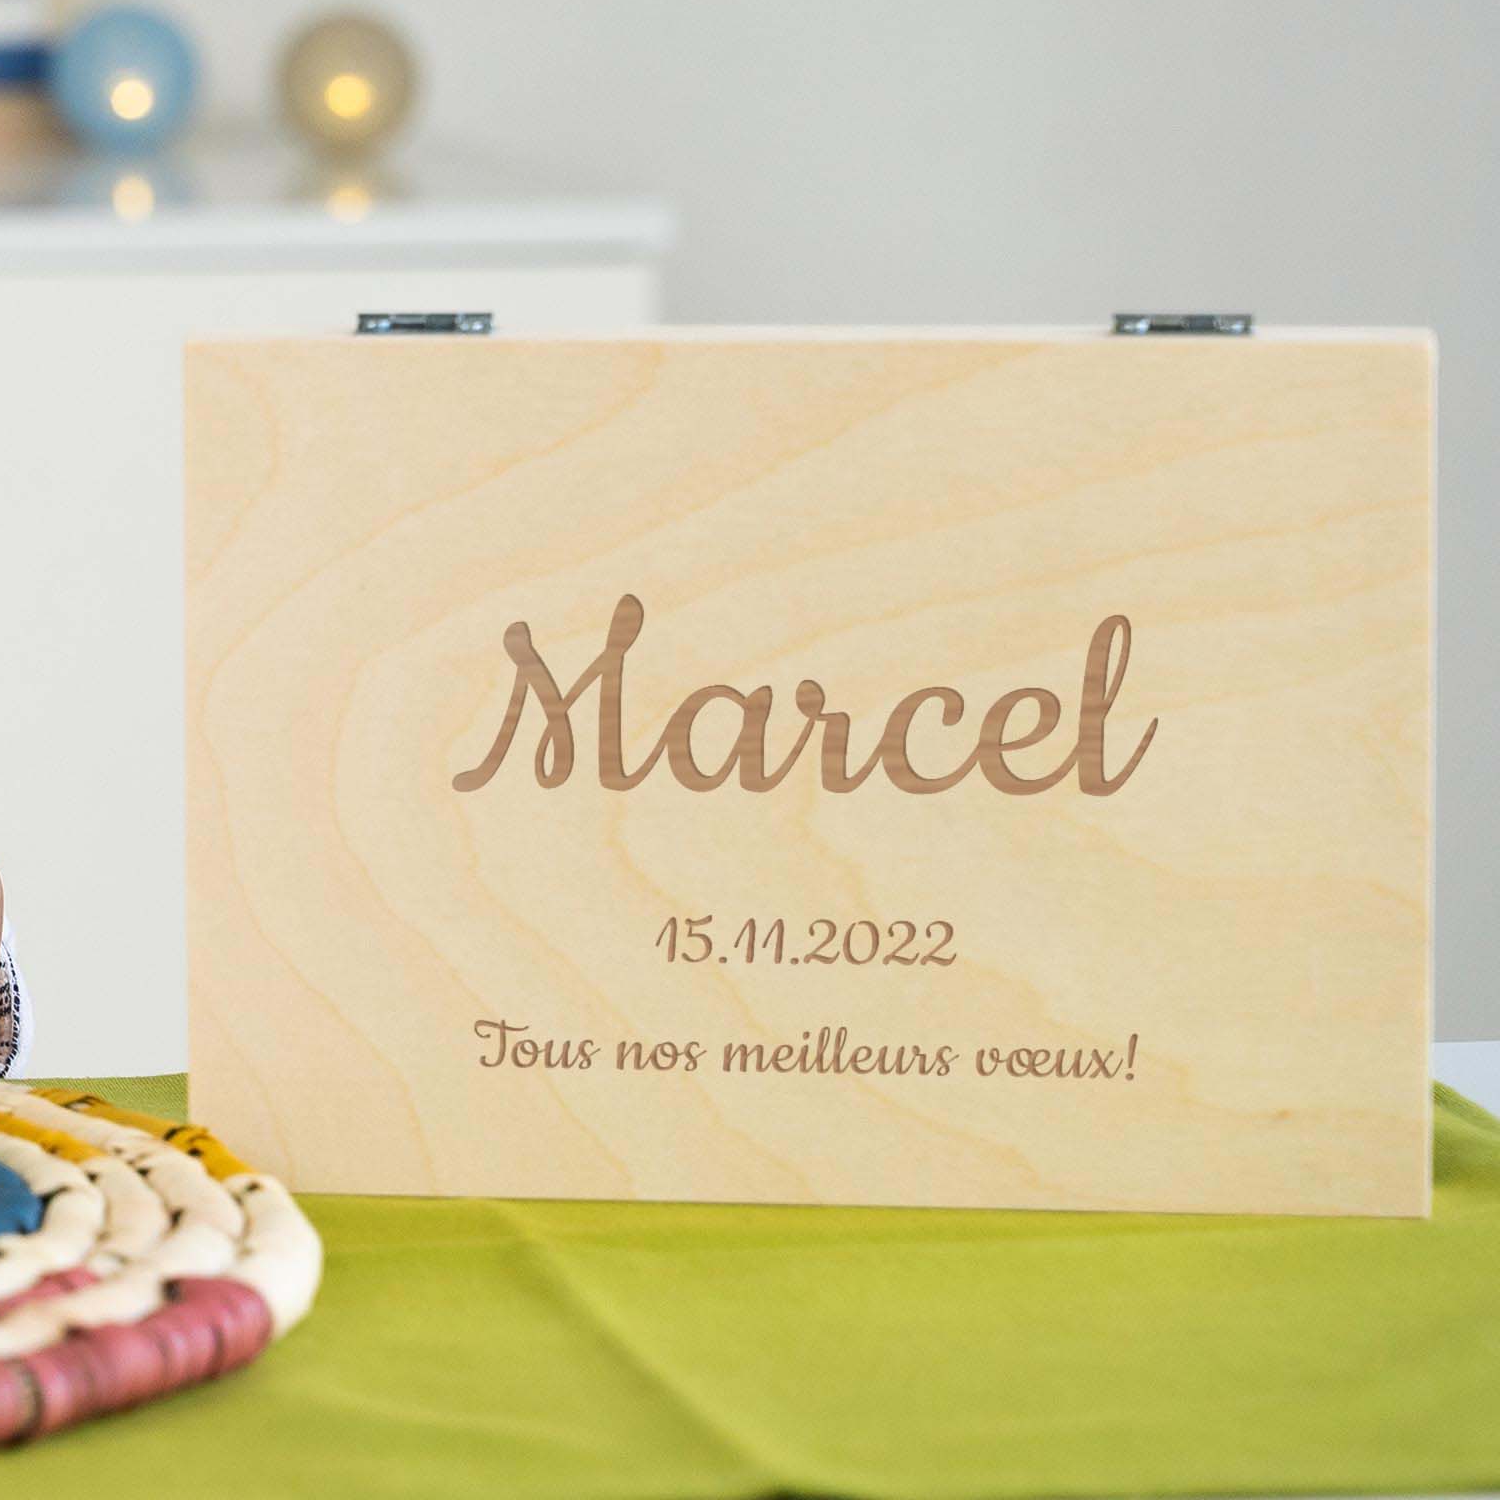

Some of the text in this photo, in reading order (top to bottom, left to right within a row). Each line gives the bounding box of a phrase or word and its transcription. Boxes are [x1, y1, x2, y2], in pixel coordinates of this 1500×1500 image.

[451, 593, 1159, 797] Marcel
[655, 914, 958, 967] 15.11.2022
[473, 1019, 1140, 1082] Tous nos meilleurs vœux!
